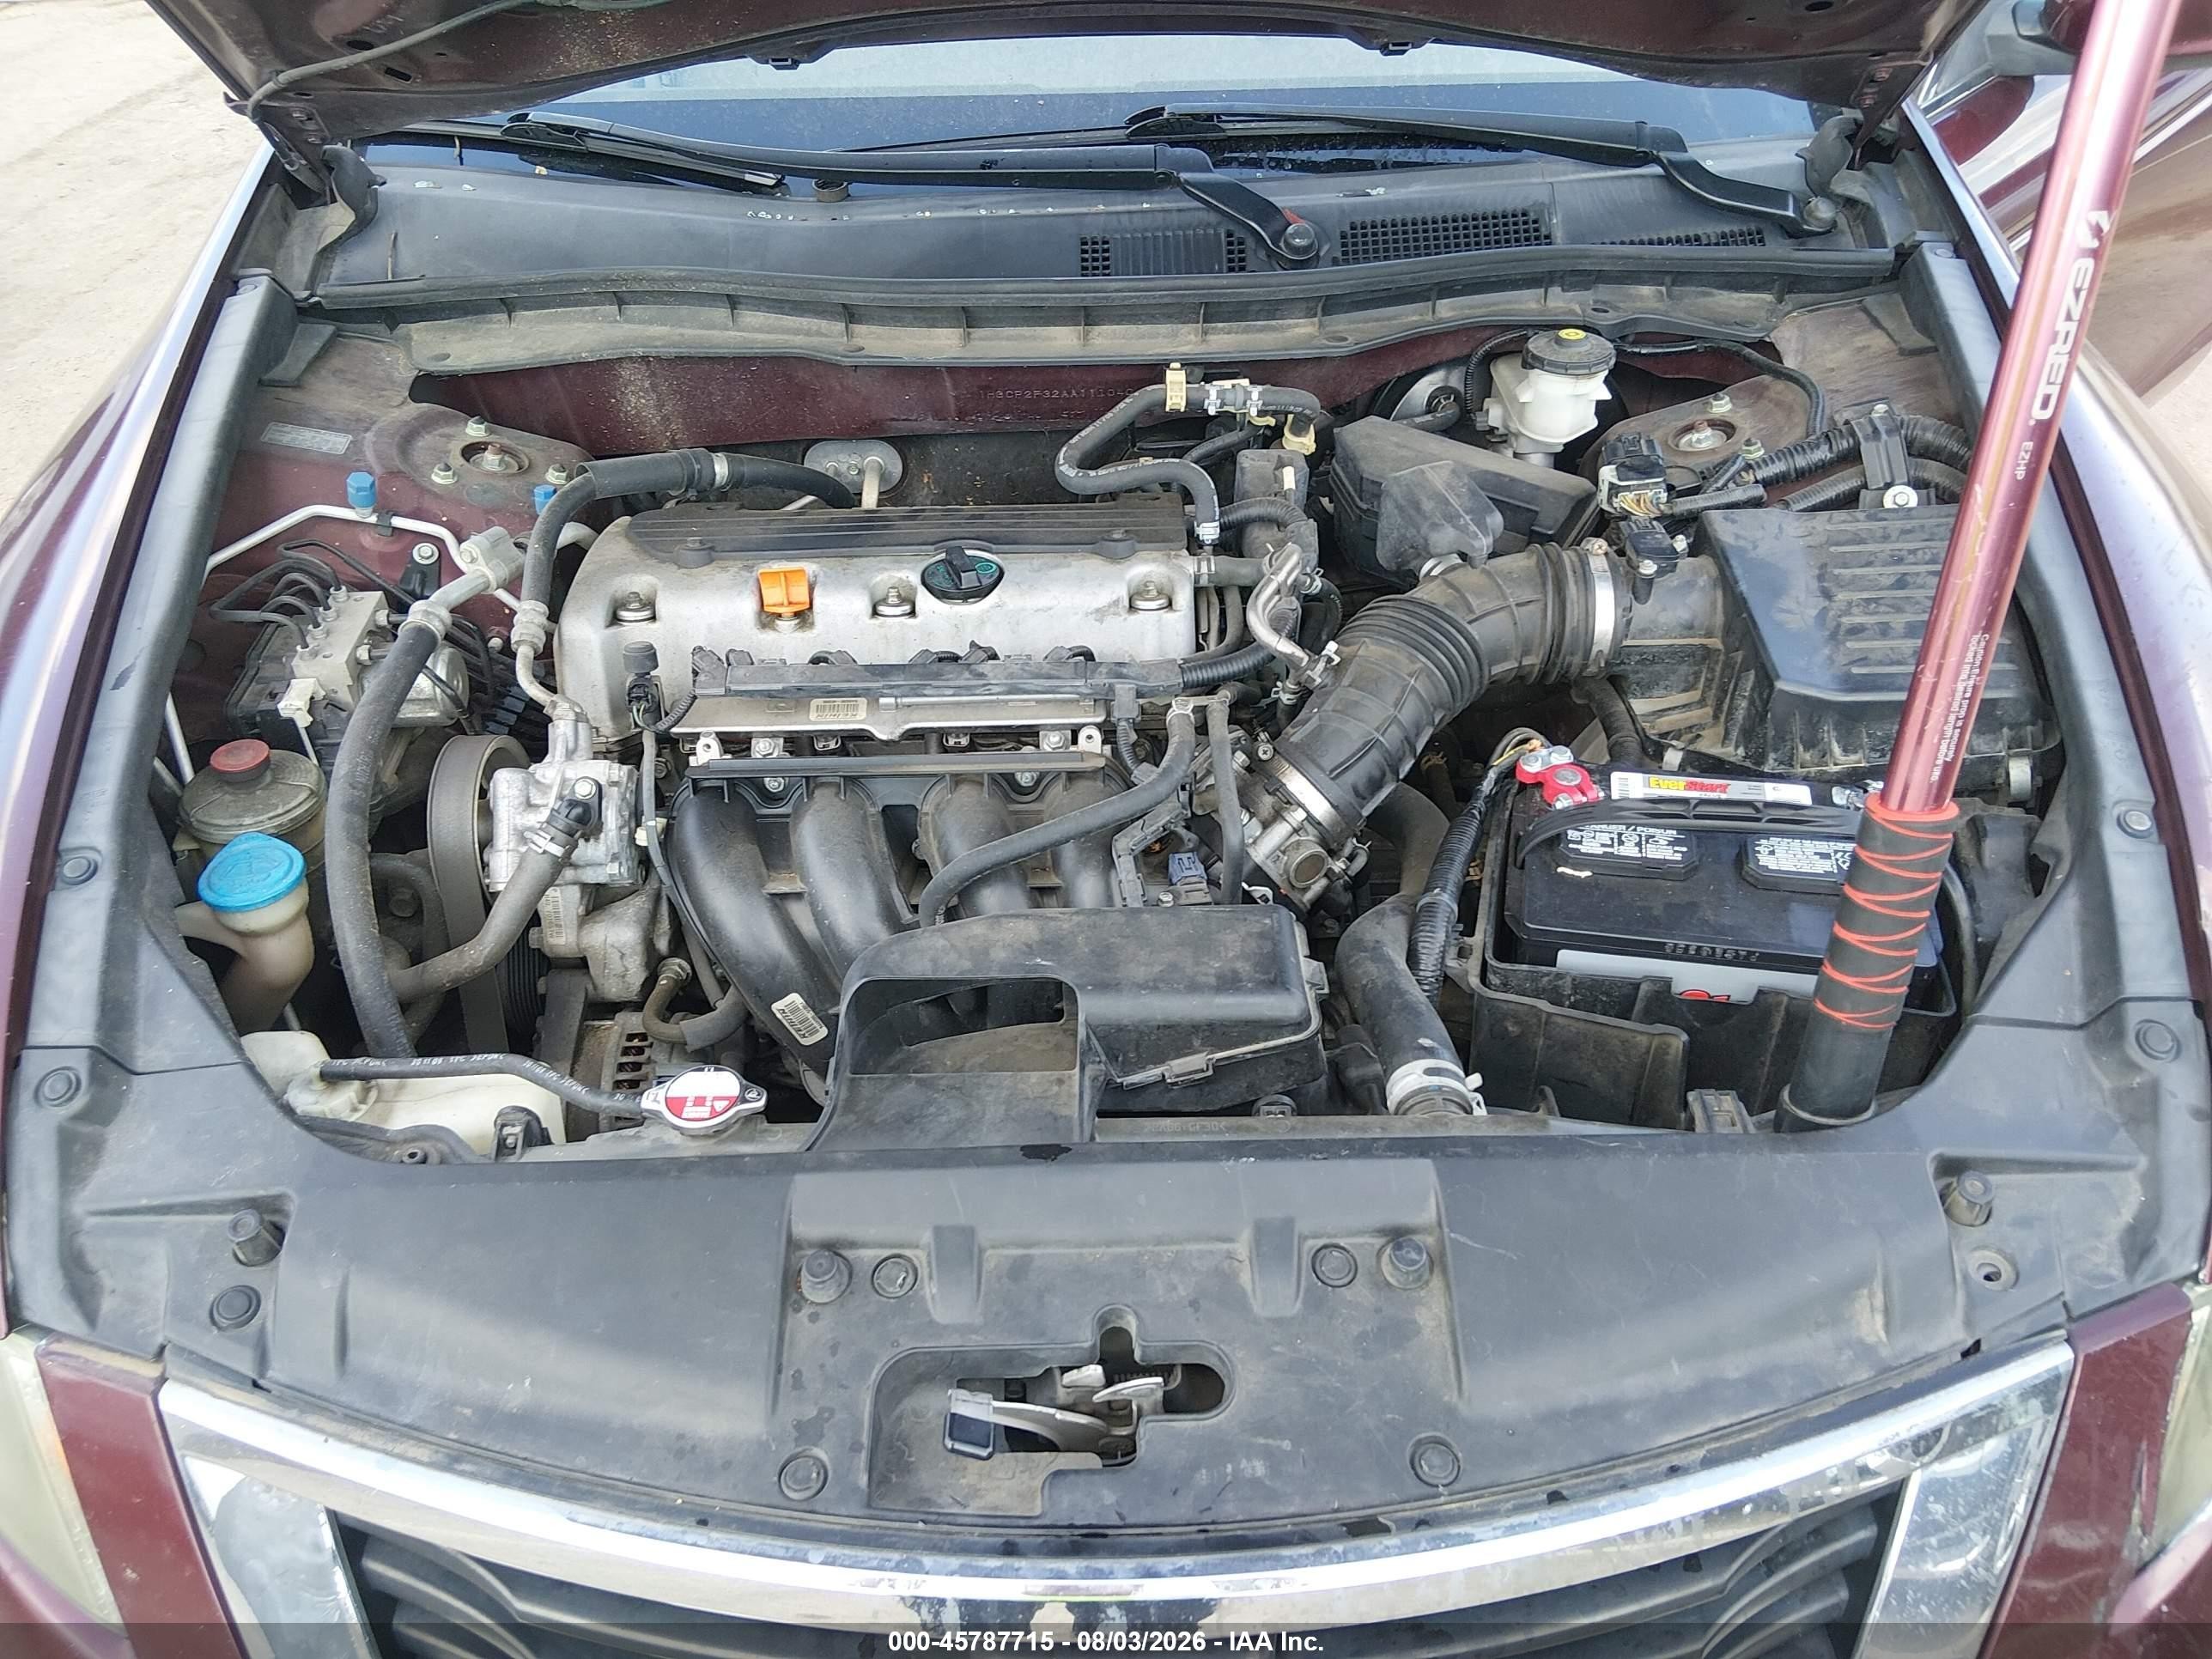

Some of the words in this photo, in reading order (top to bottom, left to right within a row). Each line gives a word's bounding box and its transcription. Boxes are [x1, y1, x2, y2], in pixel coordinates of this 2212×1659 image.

[2032, 258, 2095, 420] EZRED
[2014, 441, 2034, 481] EZHP
[1649, 776, 1731, 794] EverStart
